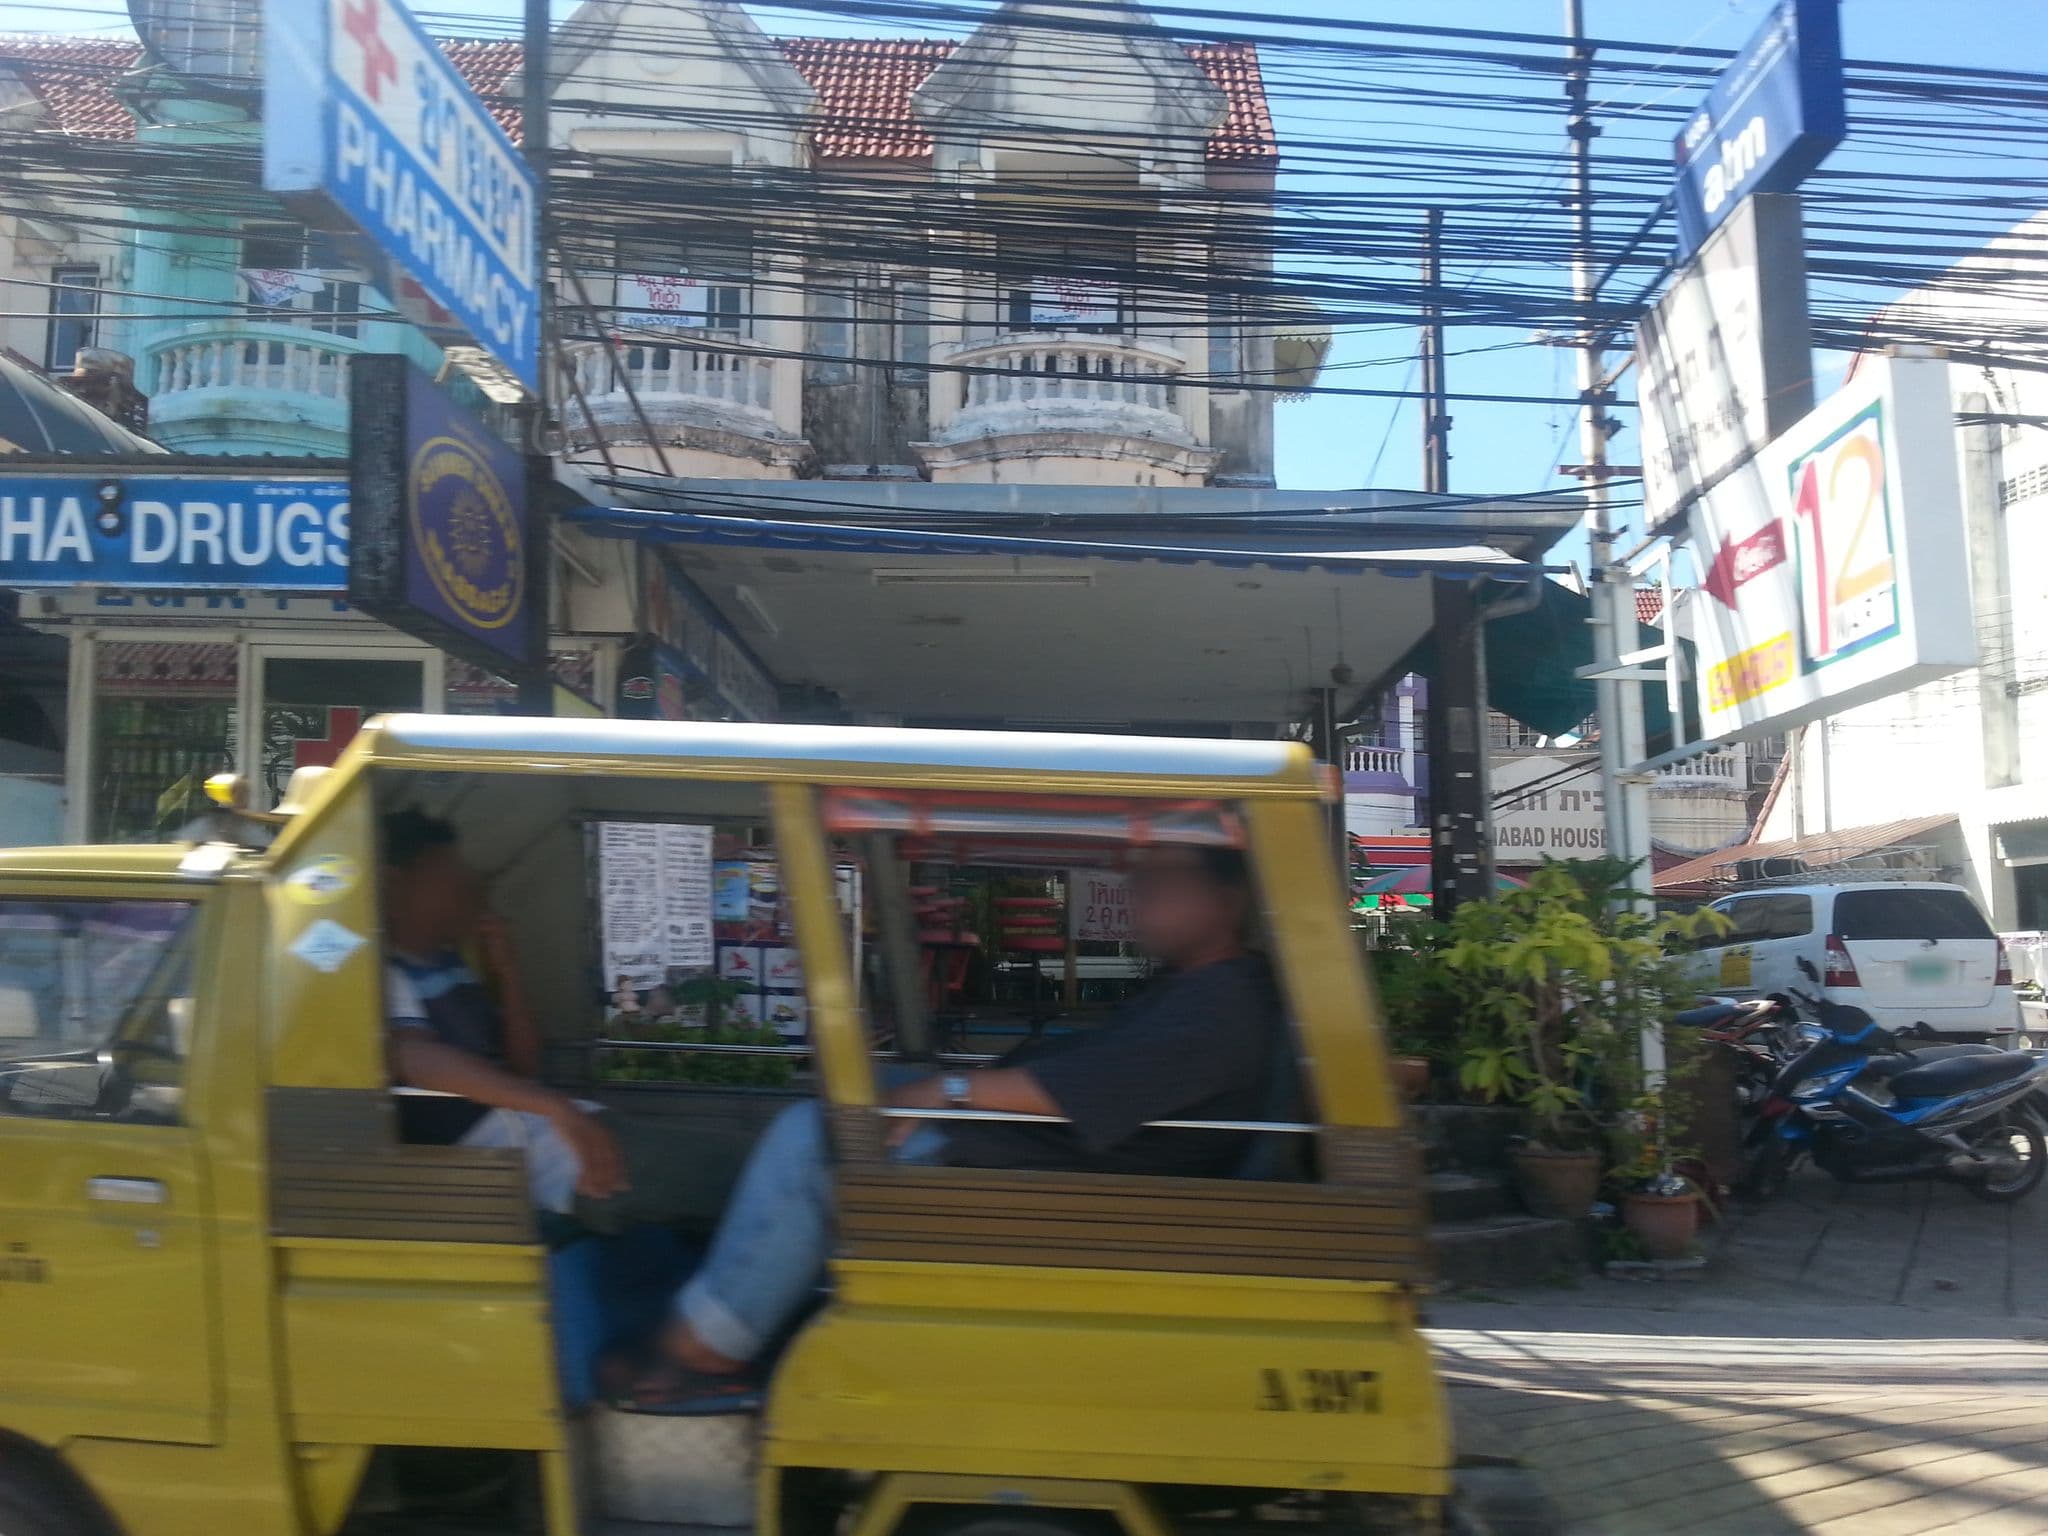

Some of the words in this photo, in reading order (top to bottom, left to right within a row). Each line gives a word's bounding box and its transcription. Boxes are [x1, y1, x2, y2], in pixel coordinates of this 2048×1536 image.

[1703, 115, 1766, 213] atm
[337, 100, 528, 361] PHARMACY
[1255, 1368, 1293, 1412] A
